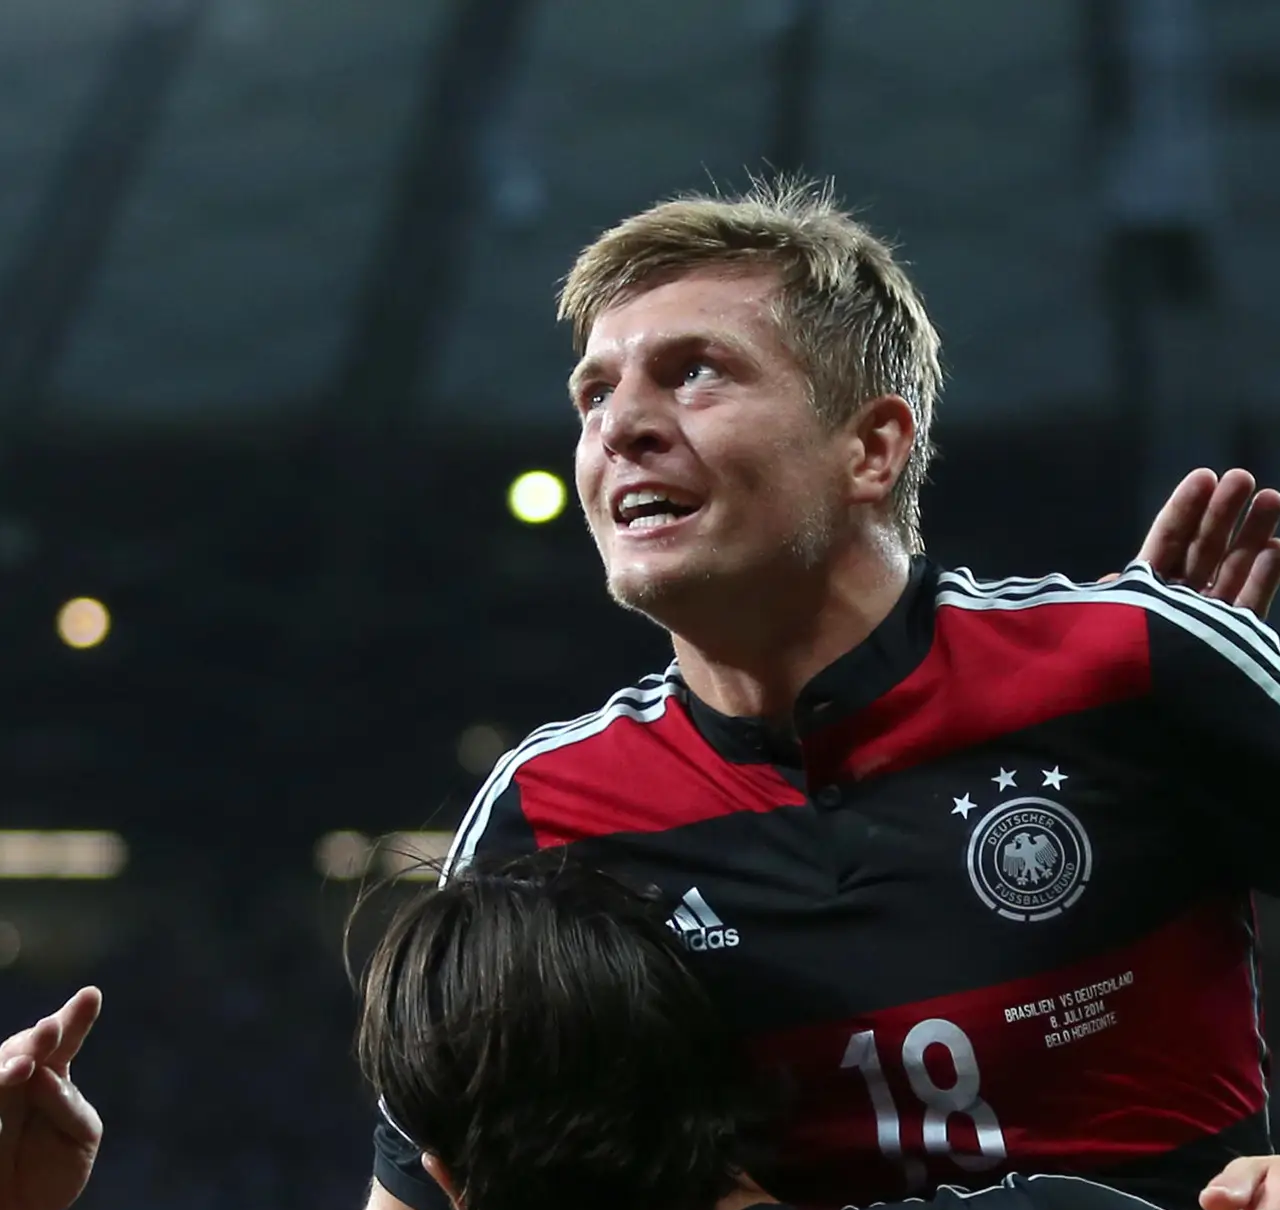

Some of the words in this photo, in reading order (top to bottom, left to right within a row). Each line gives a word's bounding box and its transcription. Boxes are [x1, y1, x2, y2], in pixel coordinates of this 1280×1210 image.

[987, 813, 1055, 846] DEUTSCHER
[1004, 998, 1056, 1023] BRASILIEN
[1059, 992, 1073, 1008] VS
[1074, 970, 1134, 1004] DEUTSCHLAND
[1063, 1007, 1083, 1026] JULI
[1083, 1000, 1105, 1018] 2014
[1045, 1029, 1071, 1048] BELO
[1071, 1011, 1118, 1040] HORIZONTE
[840, 1018, 1007, 1190] 18
